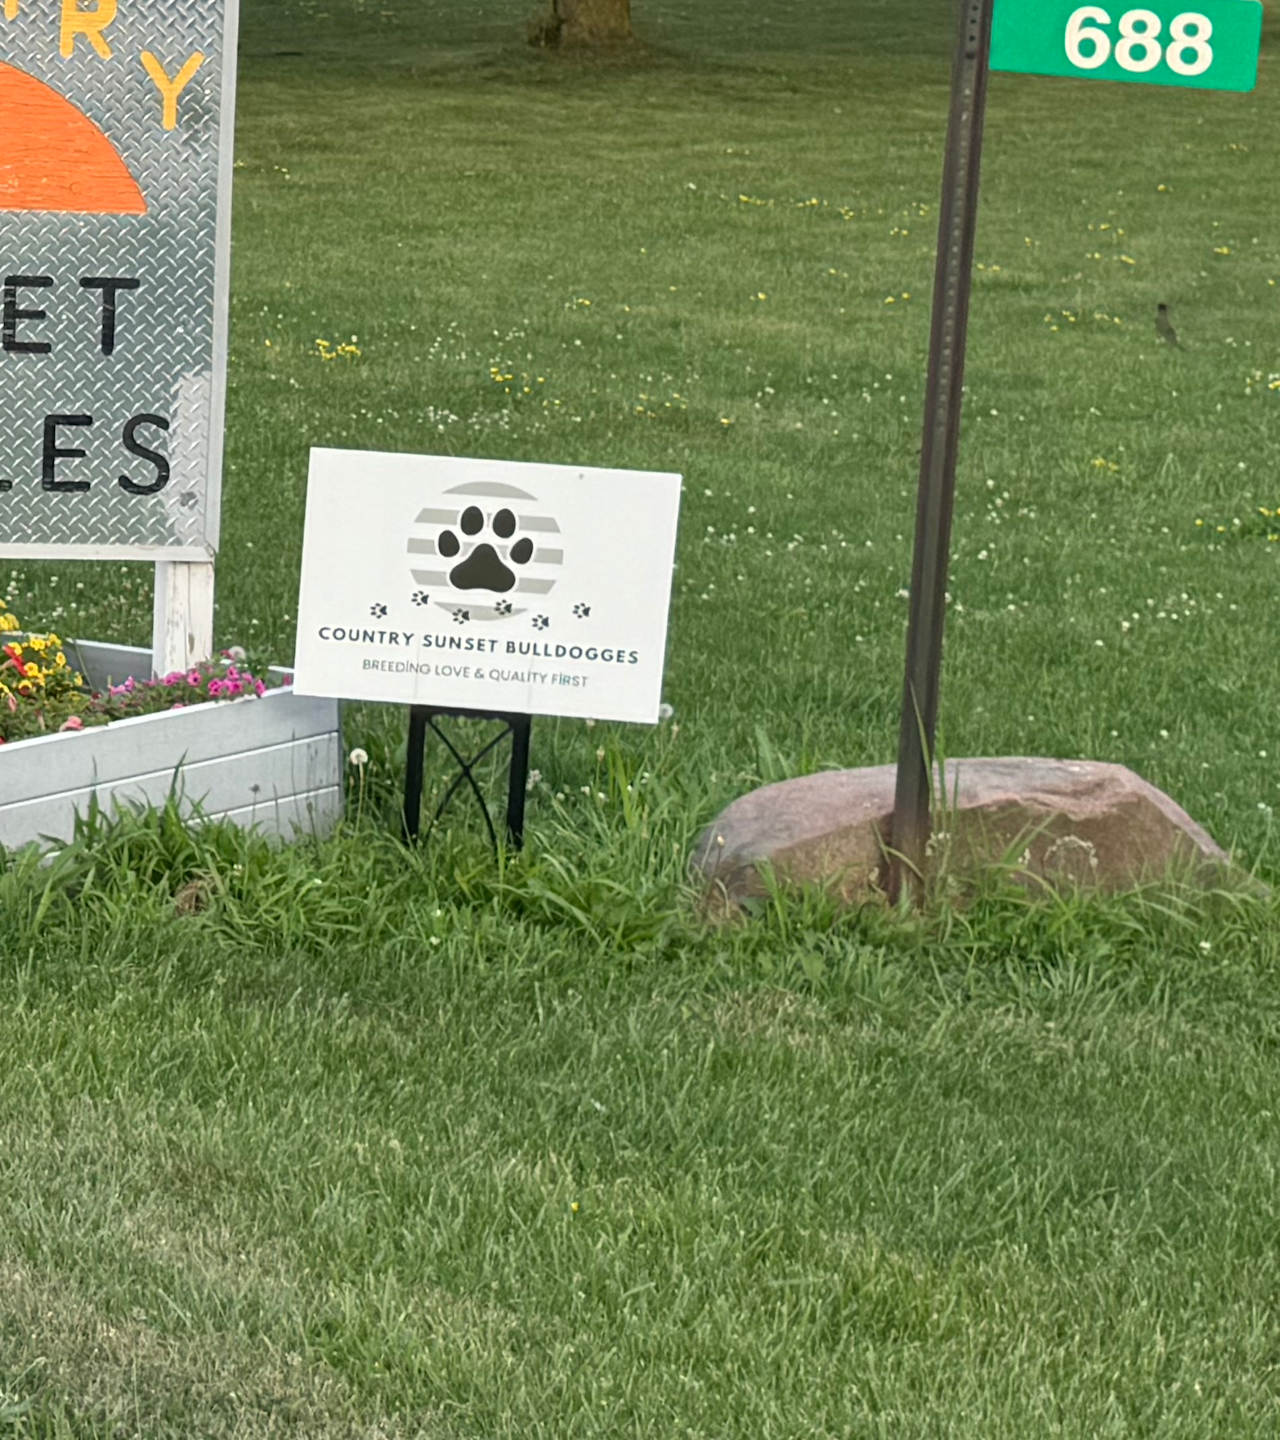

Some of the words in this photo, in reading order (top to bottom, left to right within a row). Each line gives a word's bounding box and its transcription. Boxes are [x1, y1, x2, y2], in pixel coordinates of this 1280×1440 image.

[1064, 5, 1214, 76] 688
[317, 626, 414, 647] COUNTRY
[422, 633, 498, 654] SUNSET
[505, 640, 640, 664] BULLDOGGES
[361, 658, 431, 676] BREEDING
[434, 663, 471, 679] LOVE
[473, 667, 485, 679] &
[488, 668, 547, 685] QUALITY
[550, 672, 589, 688] FIRST
